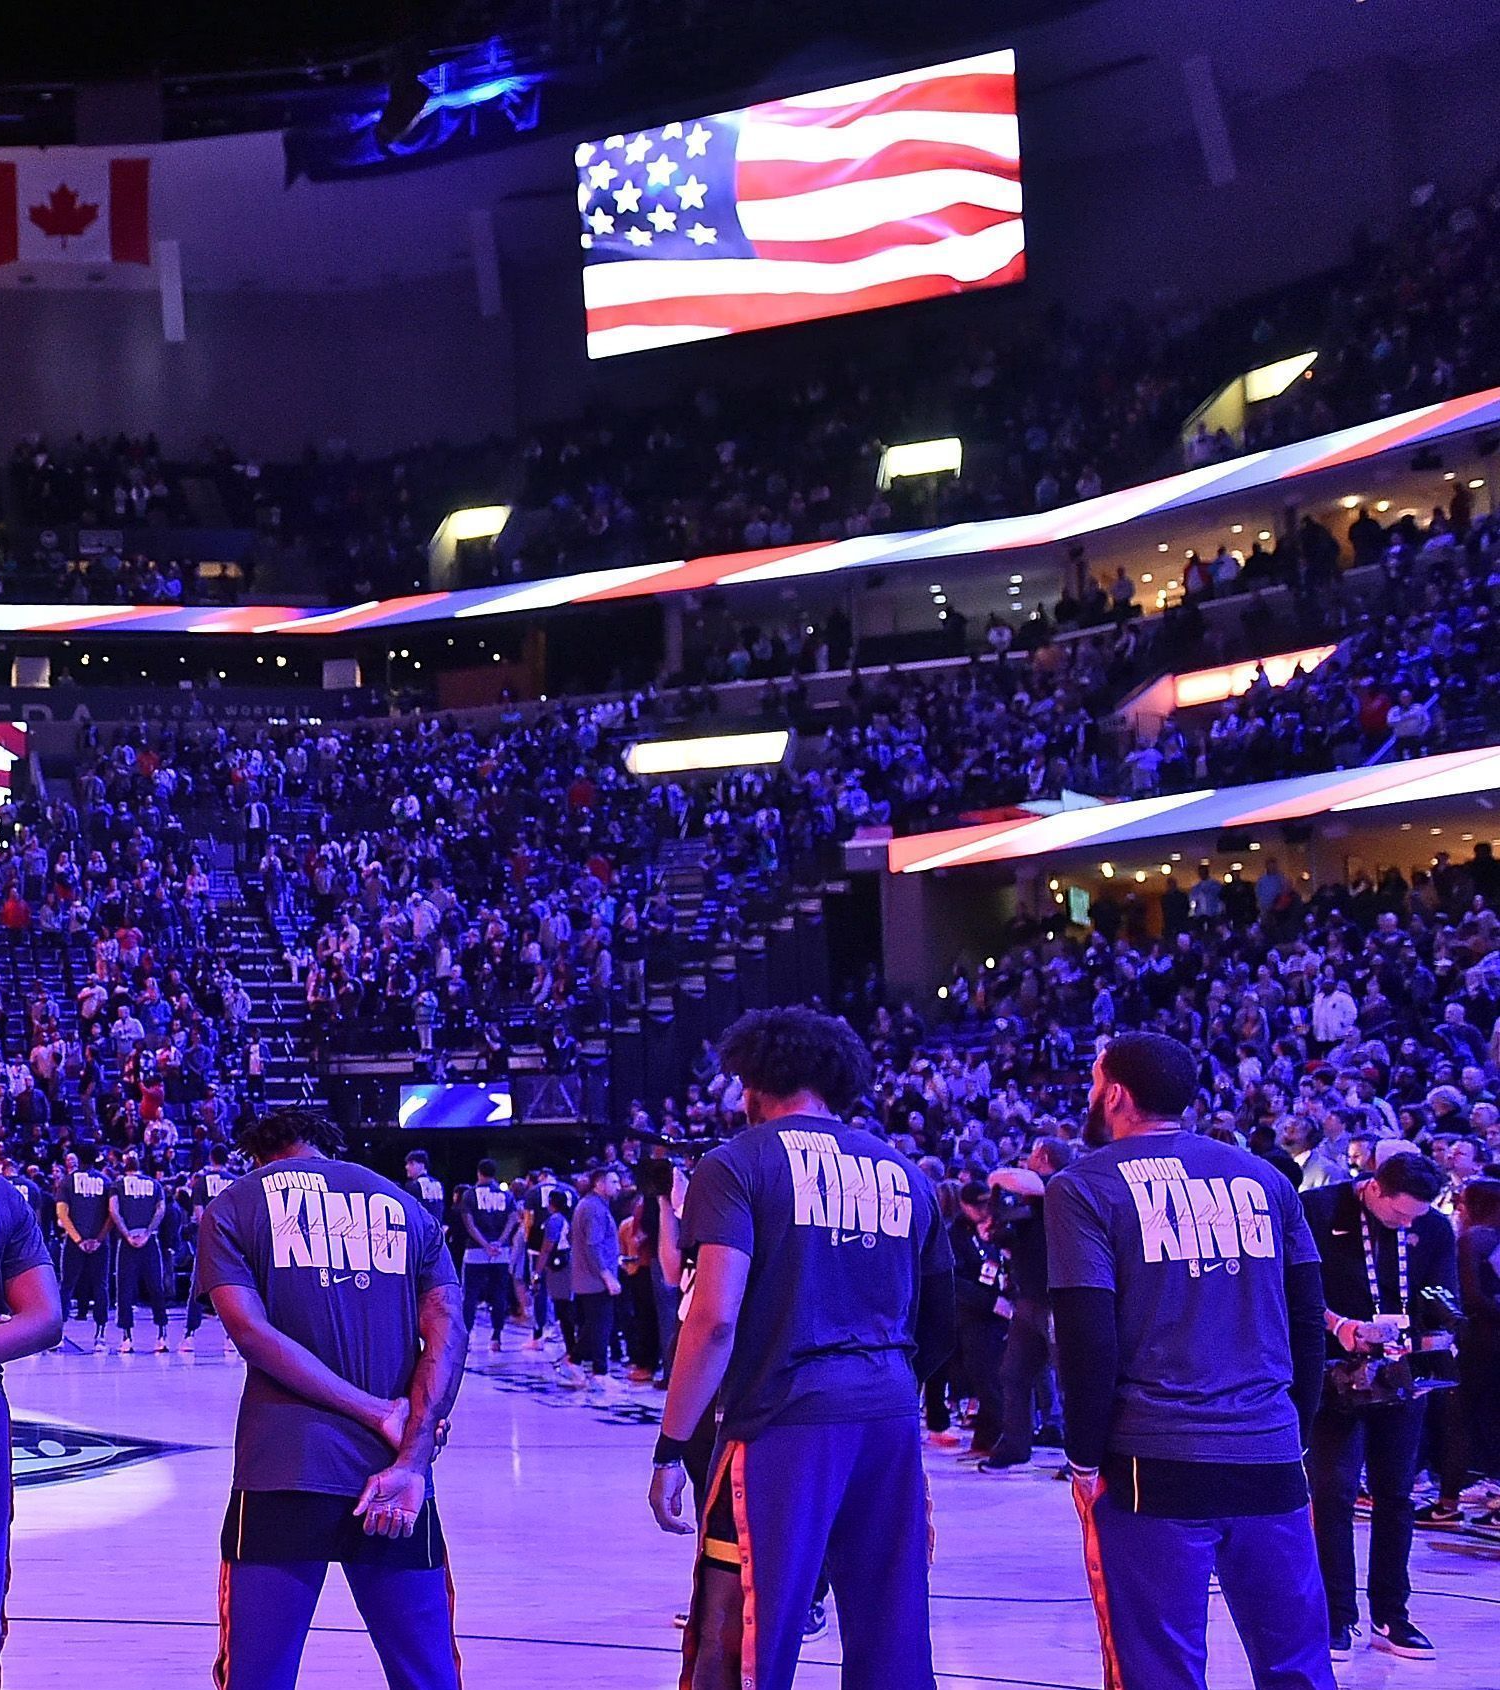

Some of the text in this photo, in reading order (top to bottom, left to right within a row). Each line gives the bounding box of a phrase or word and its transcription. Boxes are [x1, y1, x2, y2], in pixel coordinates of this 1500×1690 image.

[261, 1171, 329, 1193] HONOR
[785, 1148, 912, 1239] KING
[1117, 1157, 1189, 1184] HONOR
[265, 1188, 408, 1275] KING
[1128, 1176, 1275, 1263] KING
